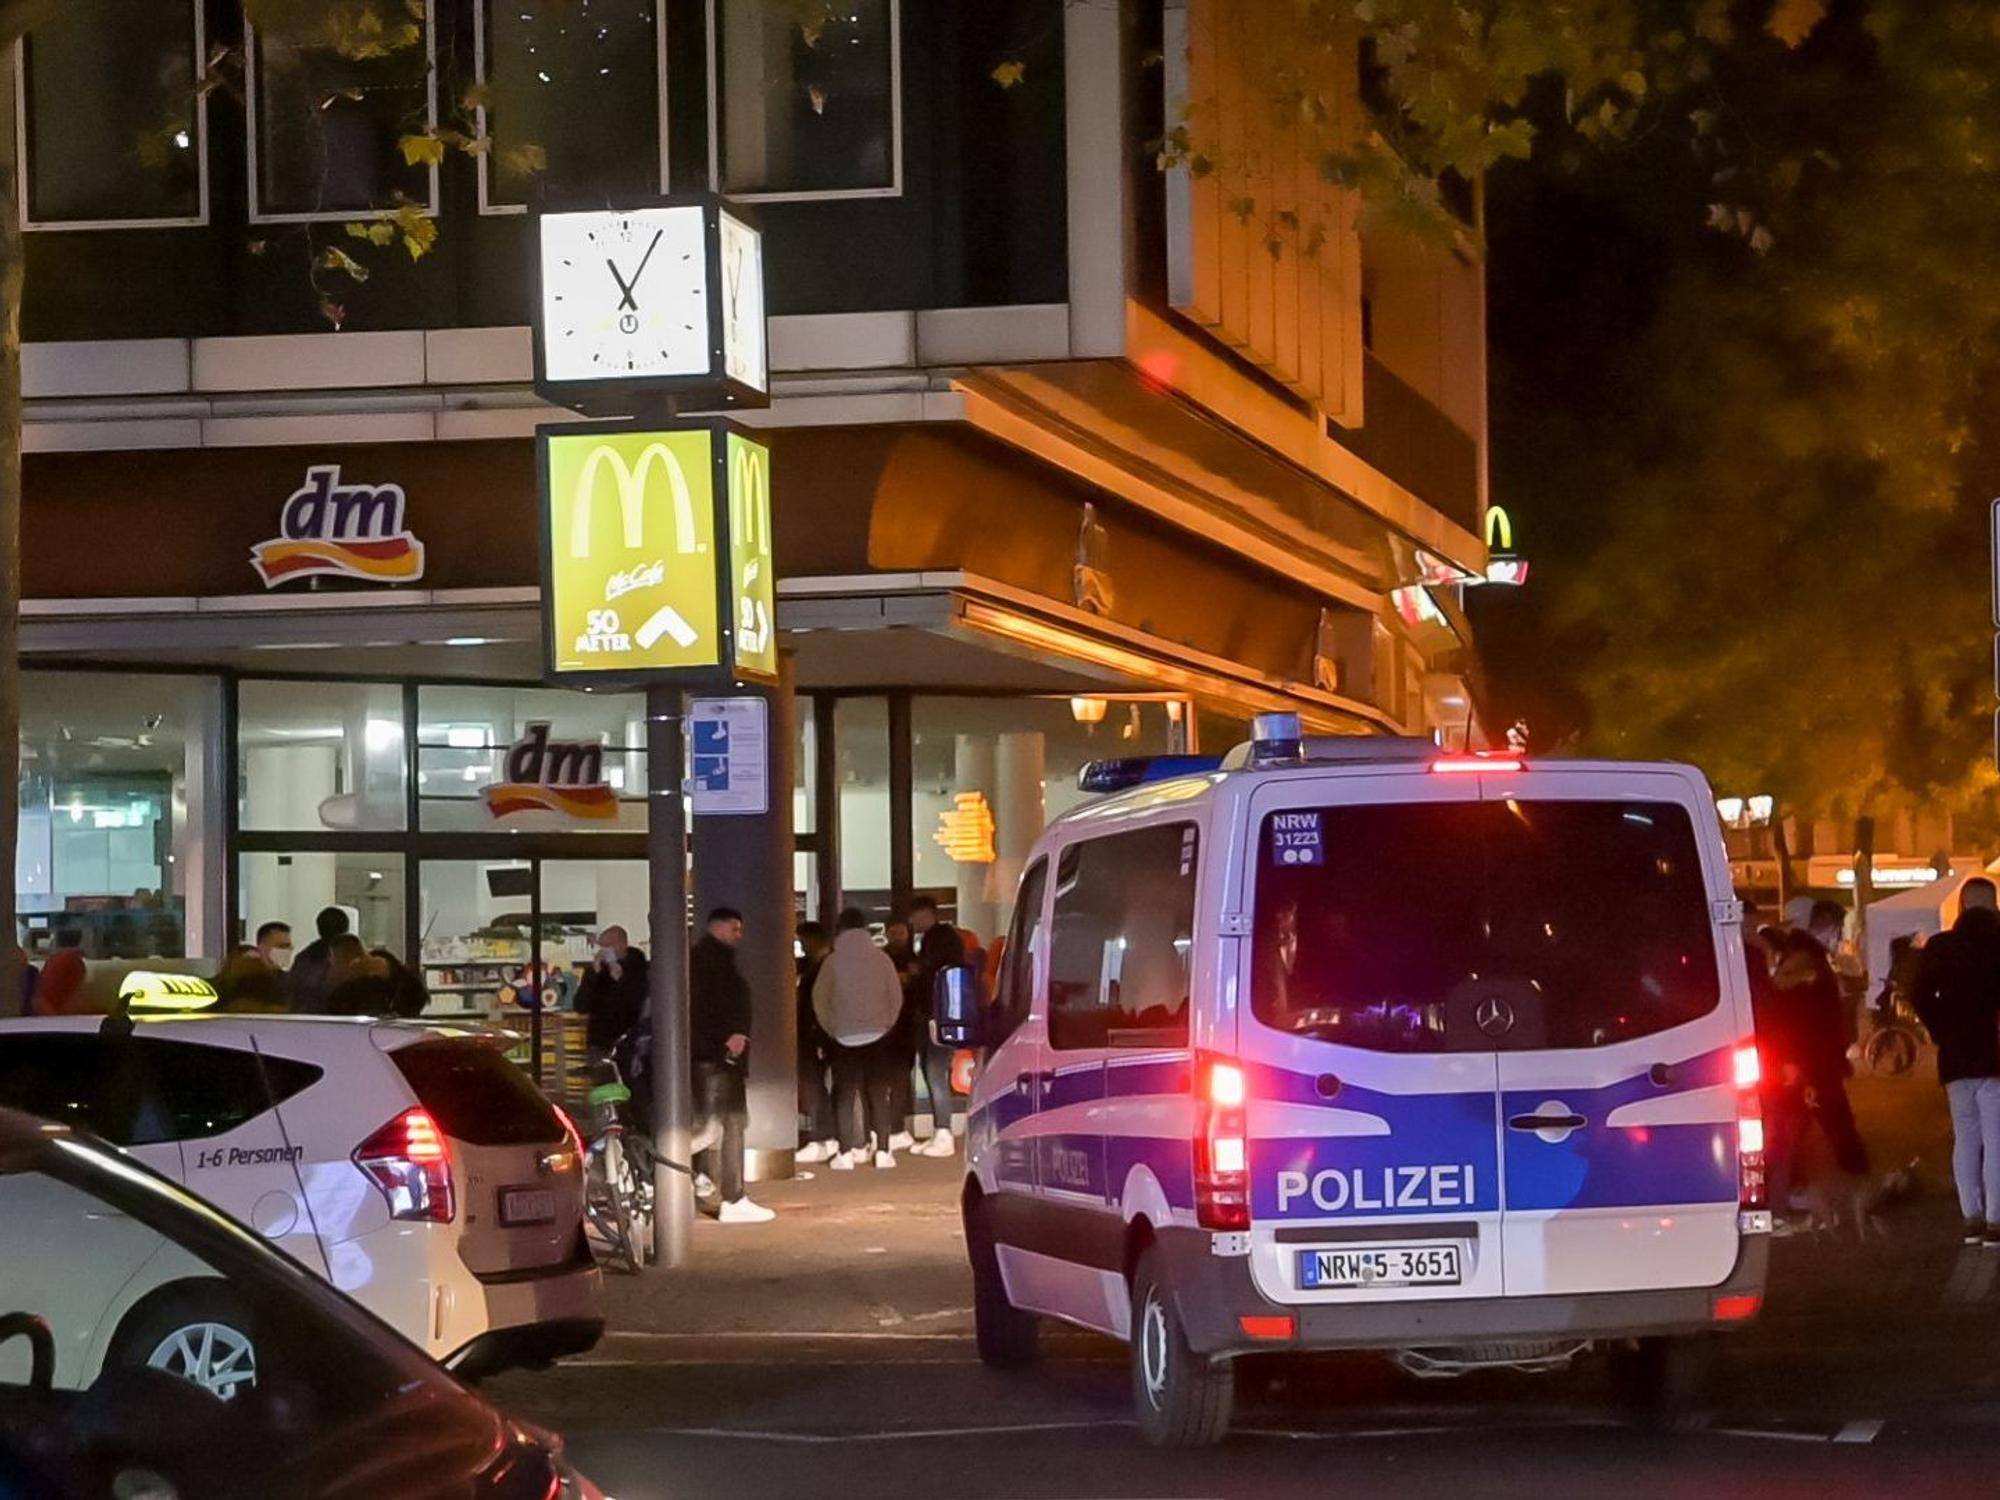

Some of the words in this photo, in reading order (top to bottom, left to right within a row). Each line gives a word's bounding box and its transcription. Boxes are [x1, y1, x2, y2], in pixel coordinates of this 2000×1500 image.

[285, 471, 398, 540] dm
[586, 609, 620, 634] 50
[509, 725, 602, 784] dm
[1273, 814, 1318, 829] NRW
[1275, 832, 1319, 846] 31223
[197, 1148, 223, 1168] 1-6
[228, 1146, 303, 1165] Personen
[1277, 1164, 1475, 1212] POLIZEI
[1317, 1255, 1360, 1281] NRW
